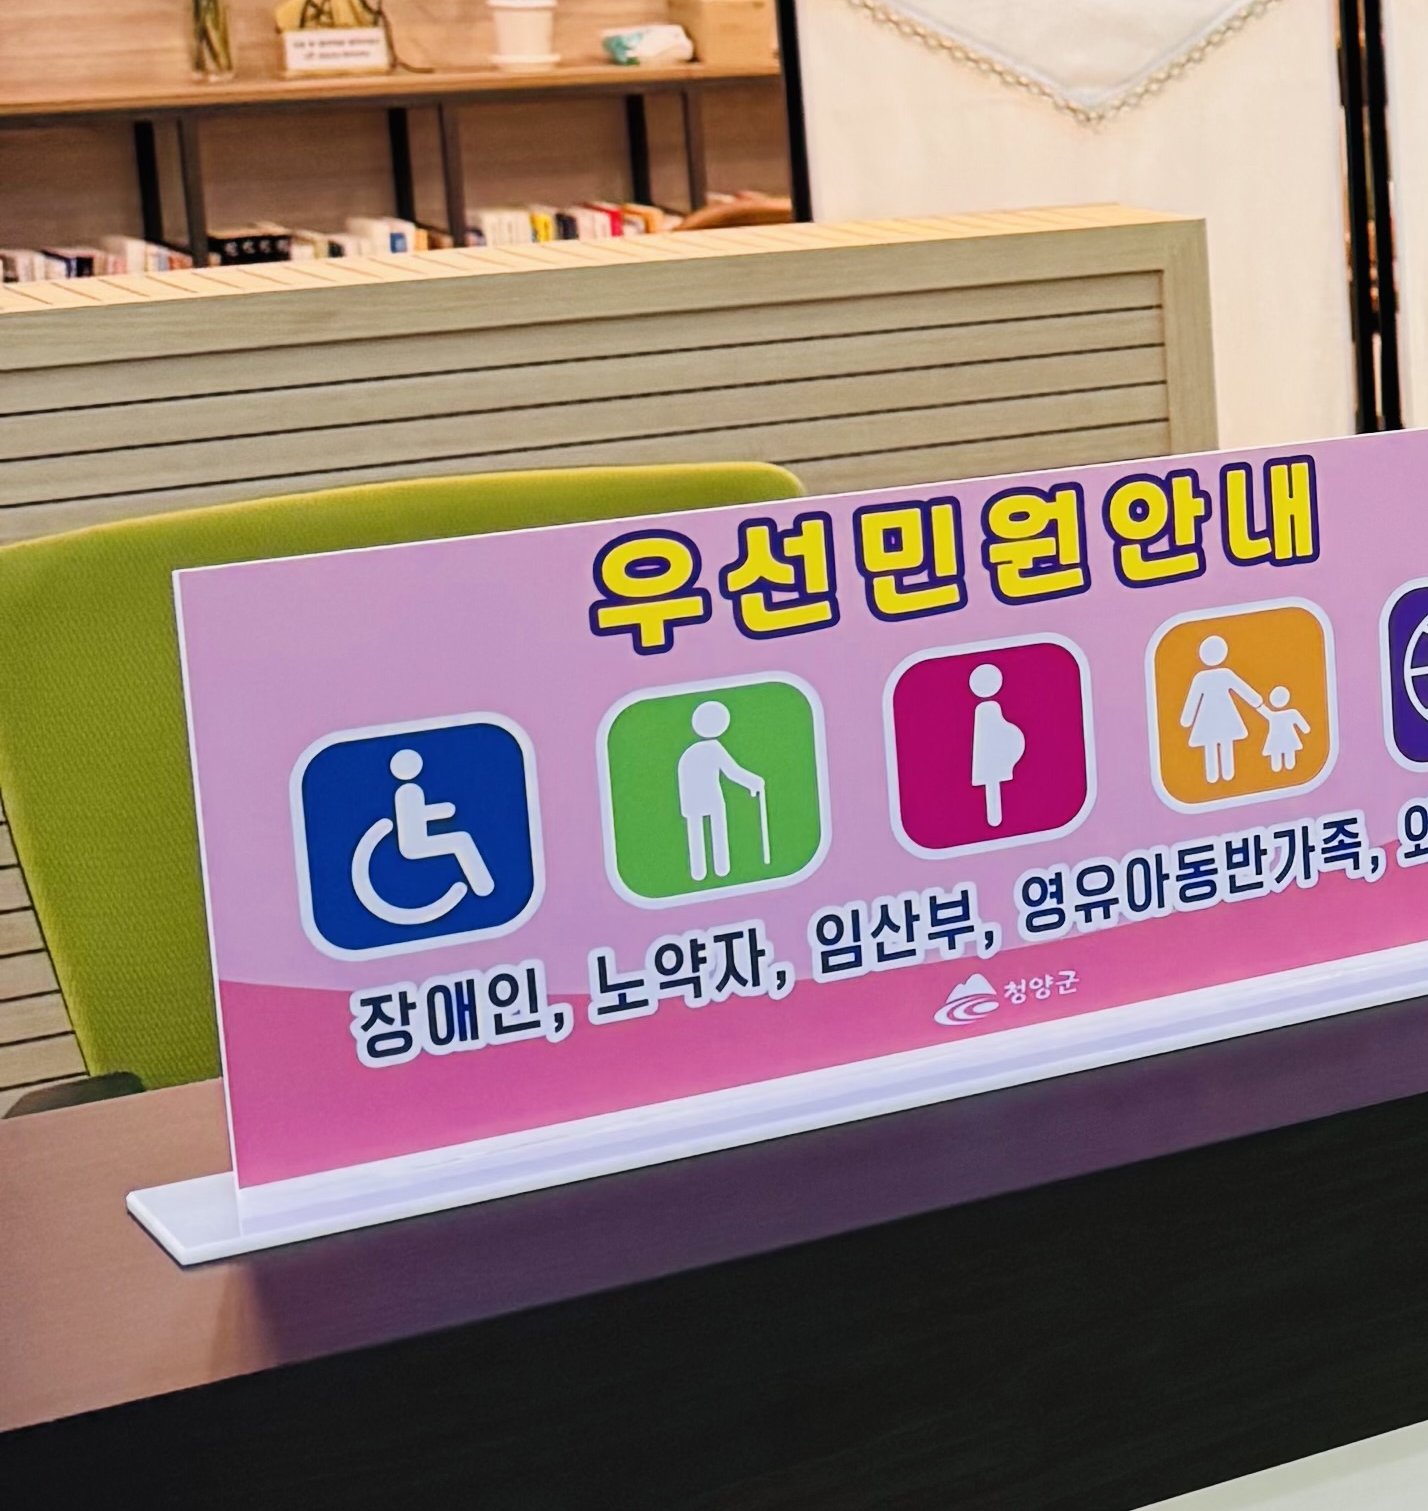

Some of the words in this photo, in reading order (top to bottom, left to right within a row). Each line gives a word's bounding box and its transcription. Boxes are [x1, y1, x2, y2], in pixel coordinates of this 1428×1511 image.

[589, 455, 1320, 656] 우선민원안내
[356, 964, 568, 1063] 장애인,
[597, 926, 790, 1017] 노약자,
[812, 888, 998, 976] 임산부,
[1020, 815, 1381, 933] 영유아동반가족,
[1002, 969, 1081, 1006] 청양군
